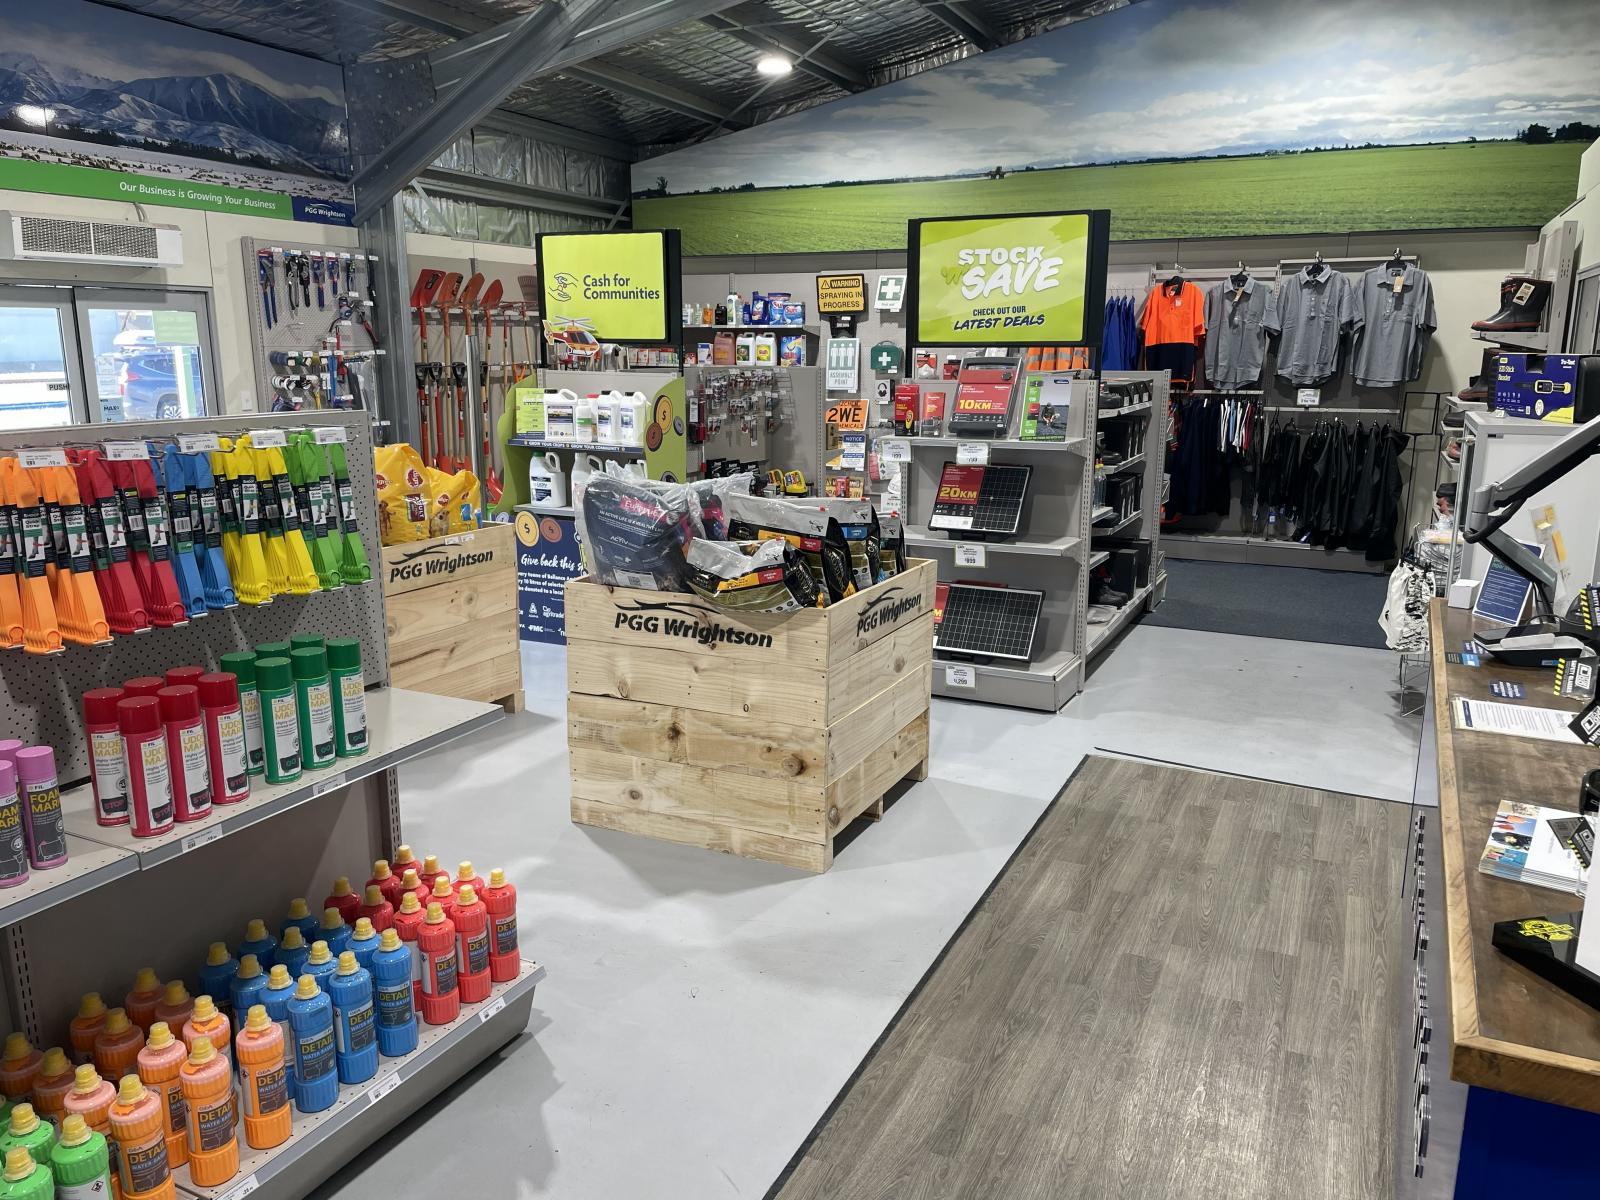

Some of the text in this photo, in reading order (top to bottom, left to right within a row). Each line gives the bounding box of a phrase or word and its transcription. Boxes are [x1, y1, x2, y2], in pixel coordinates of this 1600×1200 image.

[119, 181, 276, 209] Our Business is Growing Your Business
[305, 207, 346, 218] PGG Wrightson
[958, 246, 1045, 266] STOCK
[583, 274, 630, 287] Cash for
[961, 257, 1064, 300] SAVE
[583, 287, 660, 300] Communities
[973, 305, 1026, 316] CHECK OUT OUR
[954, 314, 1045, 331] LATEST DEALS
[960, 400, 992, 410] 10KM
[940, 487, 977, 499] 20KM
[390, 550, 494, 583] PGG Wrightson
[521, 553, 539, 566] Give
[540, 553, 558, 568] back
[560, 556, 575, 571] this
[856, 593, 922, 637] PGG Wrightson
[615, 612, 773, 648] PGG Wrightson
[94, 739, 120, 750] UDDE
[258, 1068, 285, 1086] DETA
